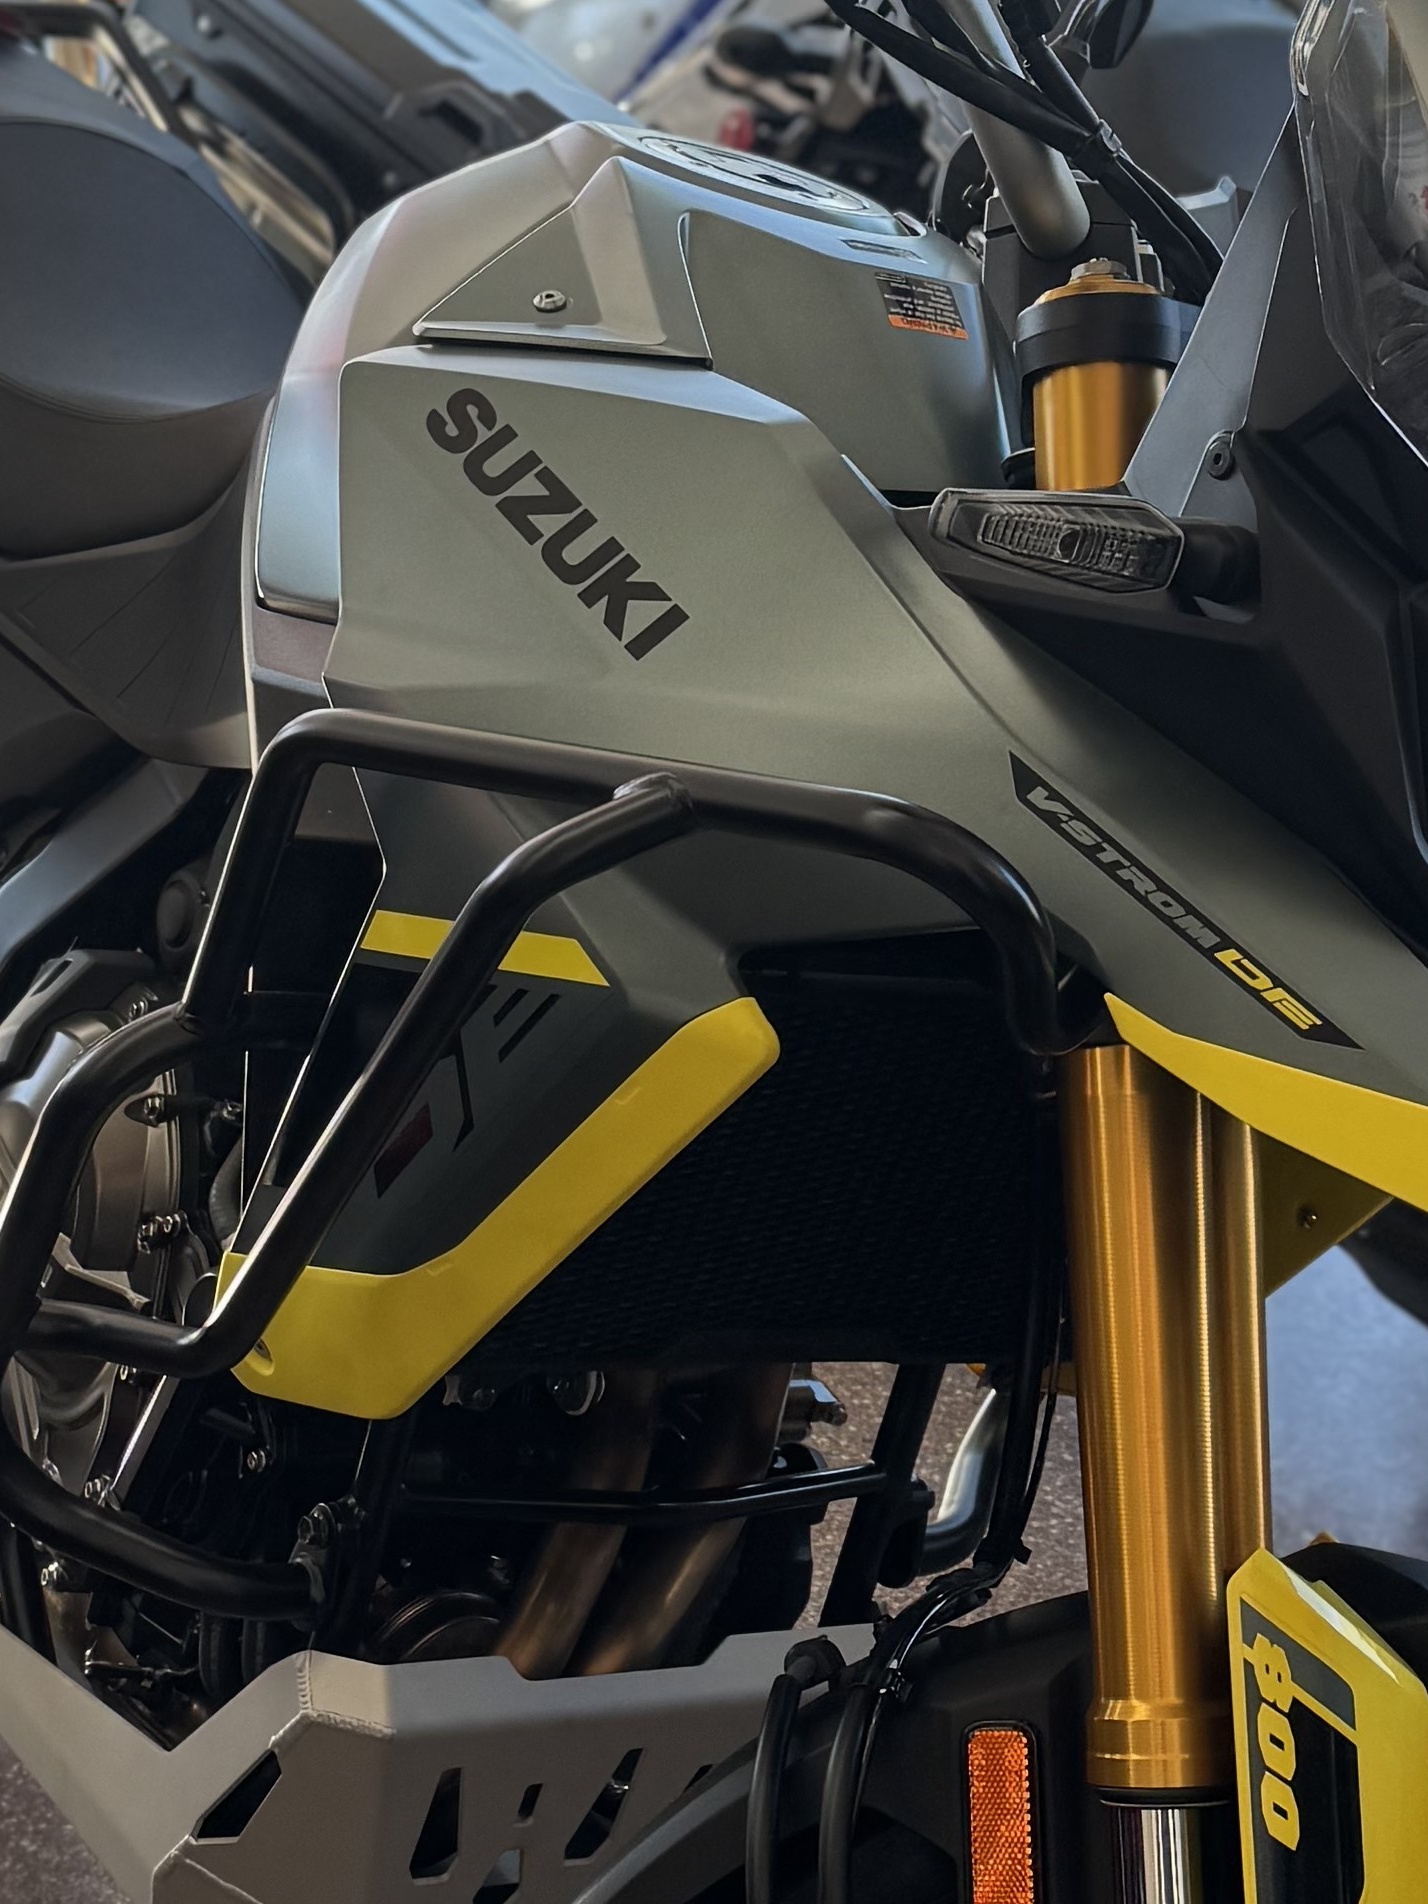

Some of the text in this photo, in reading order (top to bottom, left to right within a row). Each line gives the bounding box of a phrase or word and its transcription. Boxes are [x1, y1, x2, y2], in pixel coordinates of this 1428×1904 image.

[425, 386, 690, 662] SUZUKI
[1026, 785, 1323, 1031] V-STROM DE
[1252, 1632, 1301, 1852] 800
